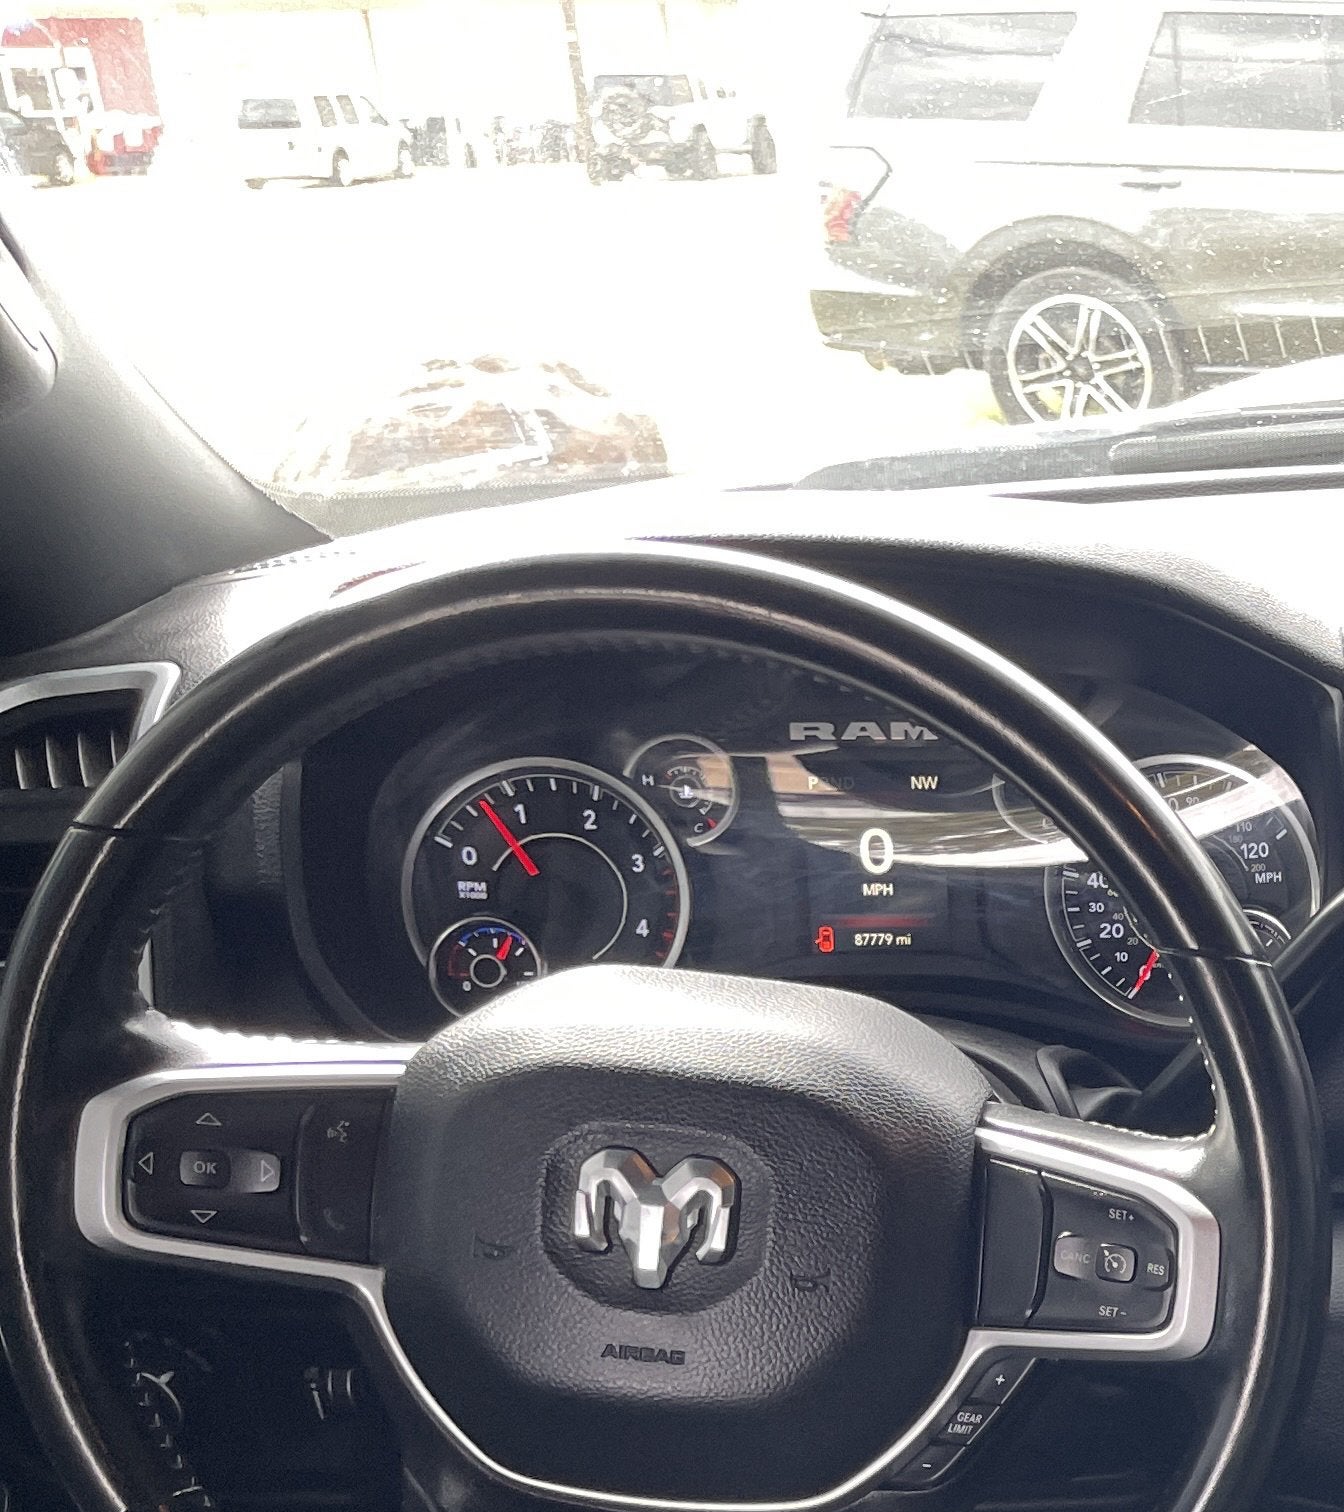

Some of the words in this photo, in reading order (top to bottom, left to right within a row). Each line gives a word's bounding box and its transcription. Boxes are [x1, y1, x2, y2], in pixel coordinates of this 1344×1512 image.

[789, 721, 939, 741] RAM
[910, 776, 938, 790] NW
[514, 803, 527, 824] 1
[582, 809, 598, 830] 2
[461, 847, 478, 866] 0
[859, 828, 894, 876] 0
[1240, 842, 1269, 859] 120
[632, 853, 646, 873] 3
[1254, 871, 1282, 884] MPH
[457, 880, 487, 891] RPM
[862, 883, 894, 896] MPH
[1088, 902, 1105, 913] 30
[635, 918, 649, 937] 4
[1099, 923, 1124, 939] 20
[854, 934, 893, 946] 87779
[896, 934, 912, 945] mi
[1114, 952, 1129, 963] 10
[192, 1160, 217, 1175] OK
[1060, 1251, 1091, 1265] CANC
[1147, 1262, 1165, 1276] RES
[600, 1343, 686, 1365] AIRBAG
[957, 1411, 982, 1424] GEAR
[948, 1423, 974, 1435] LIMIT
